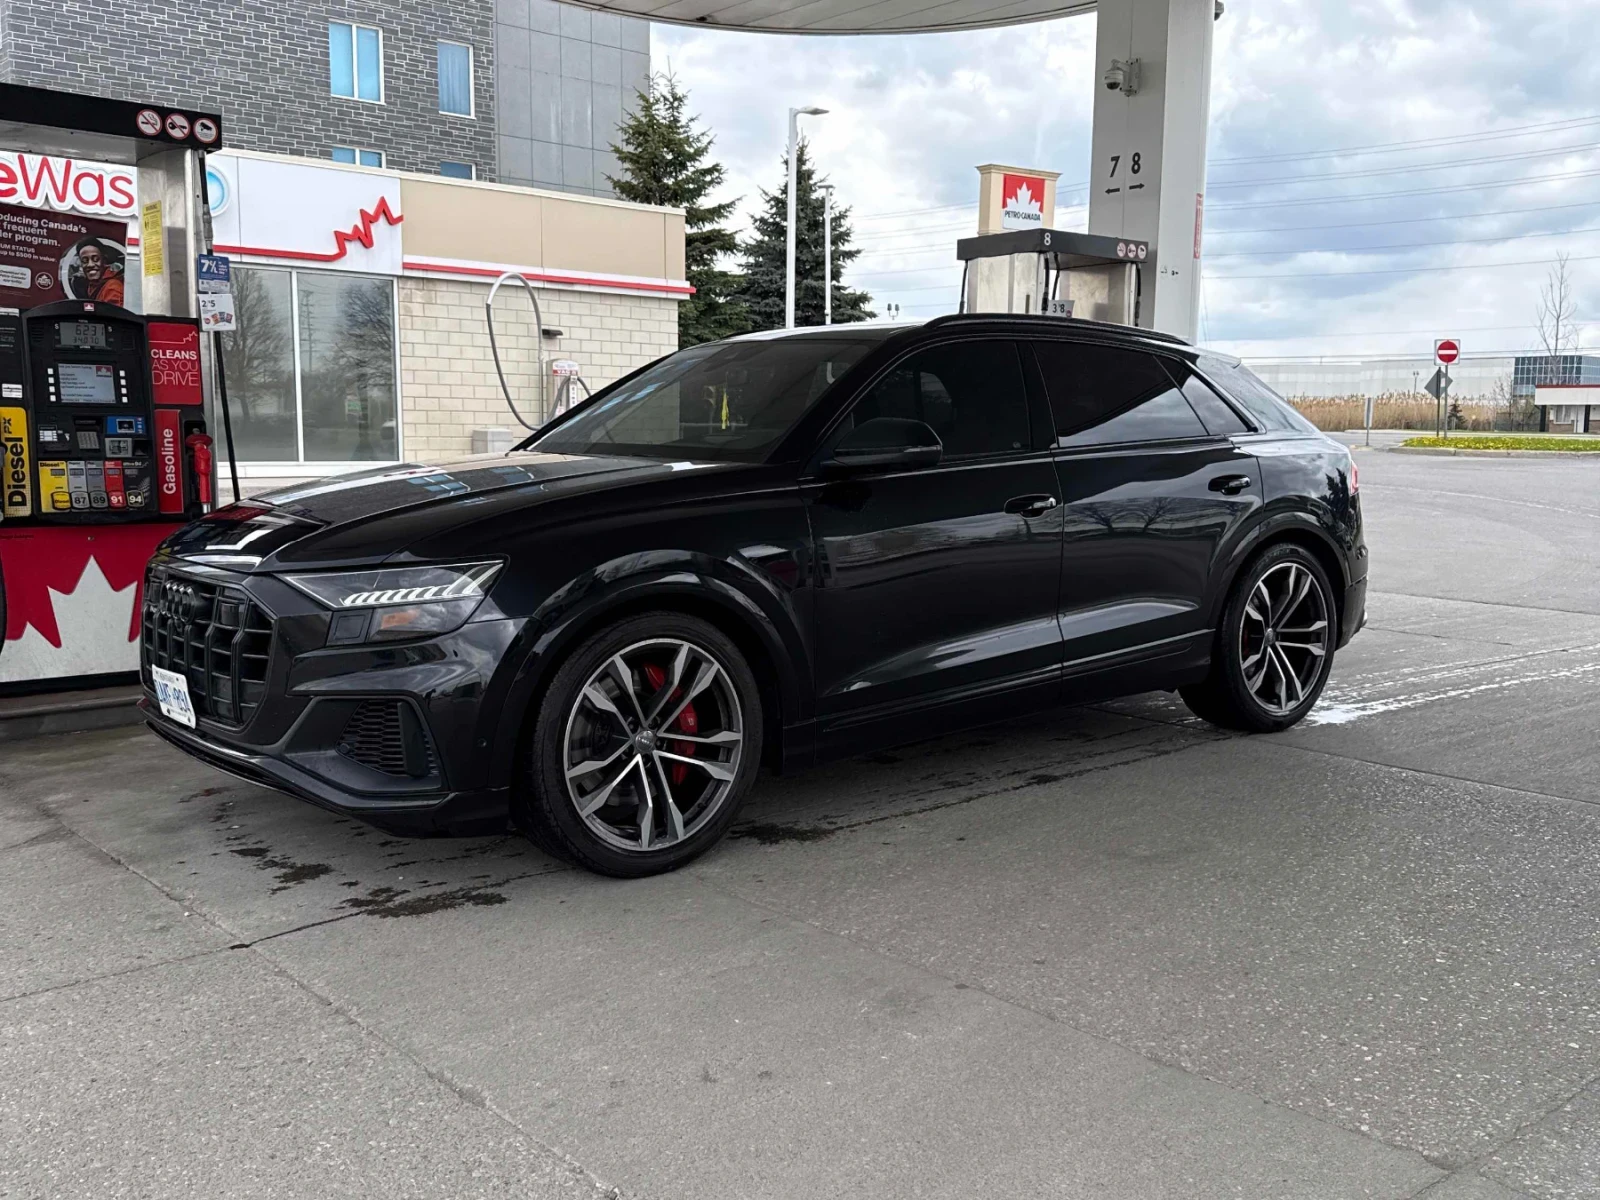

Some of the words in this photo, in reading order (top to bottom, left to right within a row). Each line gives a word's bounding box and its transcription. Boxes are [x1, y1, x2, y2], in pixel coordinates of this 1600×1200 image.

[1110, 155, 1120, 178] 7
[1131, 152, 1141, 174] 8
[3, 222, 48, 236] frequent
[40, 219, 87, 234] Canada's
[15, 233, 61, 247] program.
[1044, 232, 1051, 246] 8
[11, 245, 36, 253] STATUS
[1052, 303, 1057, 313] 3
[151, 348, 198, 360] CLEANS
[152, 359, 169, 370] AS
[171, 360, 198, 371] YOU
[152, 371, 199, 386] DRIVE
[3, 417, 12, 434] PX
[161, 428, 176, 494] Gasoline
[4, 437, 27, 507] Diesel
[74, 496, 86, 505] 87
[92, 496, 106, 504] 89
[110, 495, 123, 504] 91
[129, 495, 142, 503] 94
